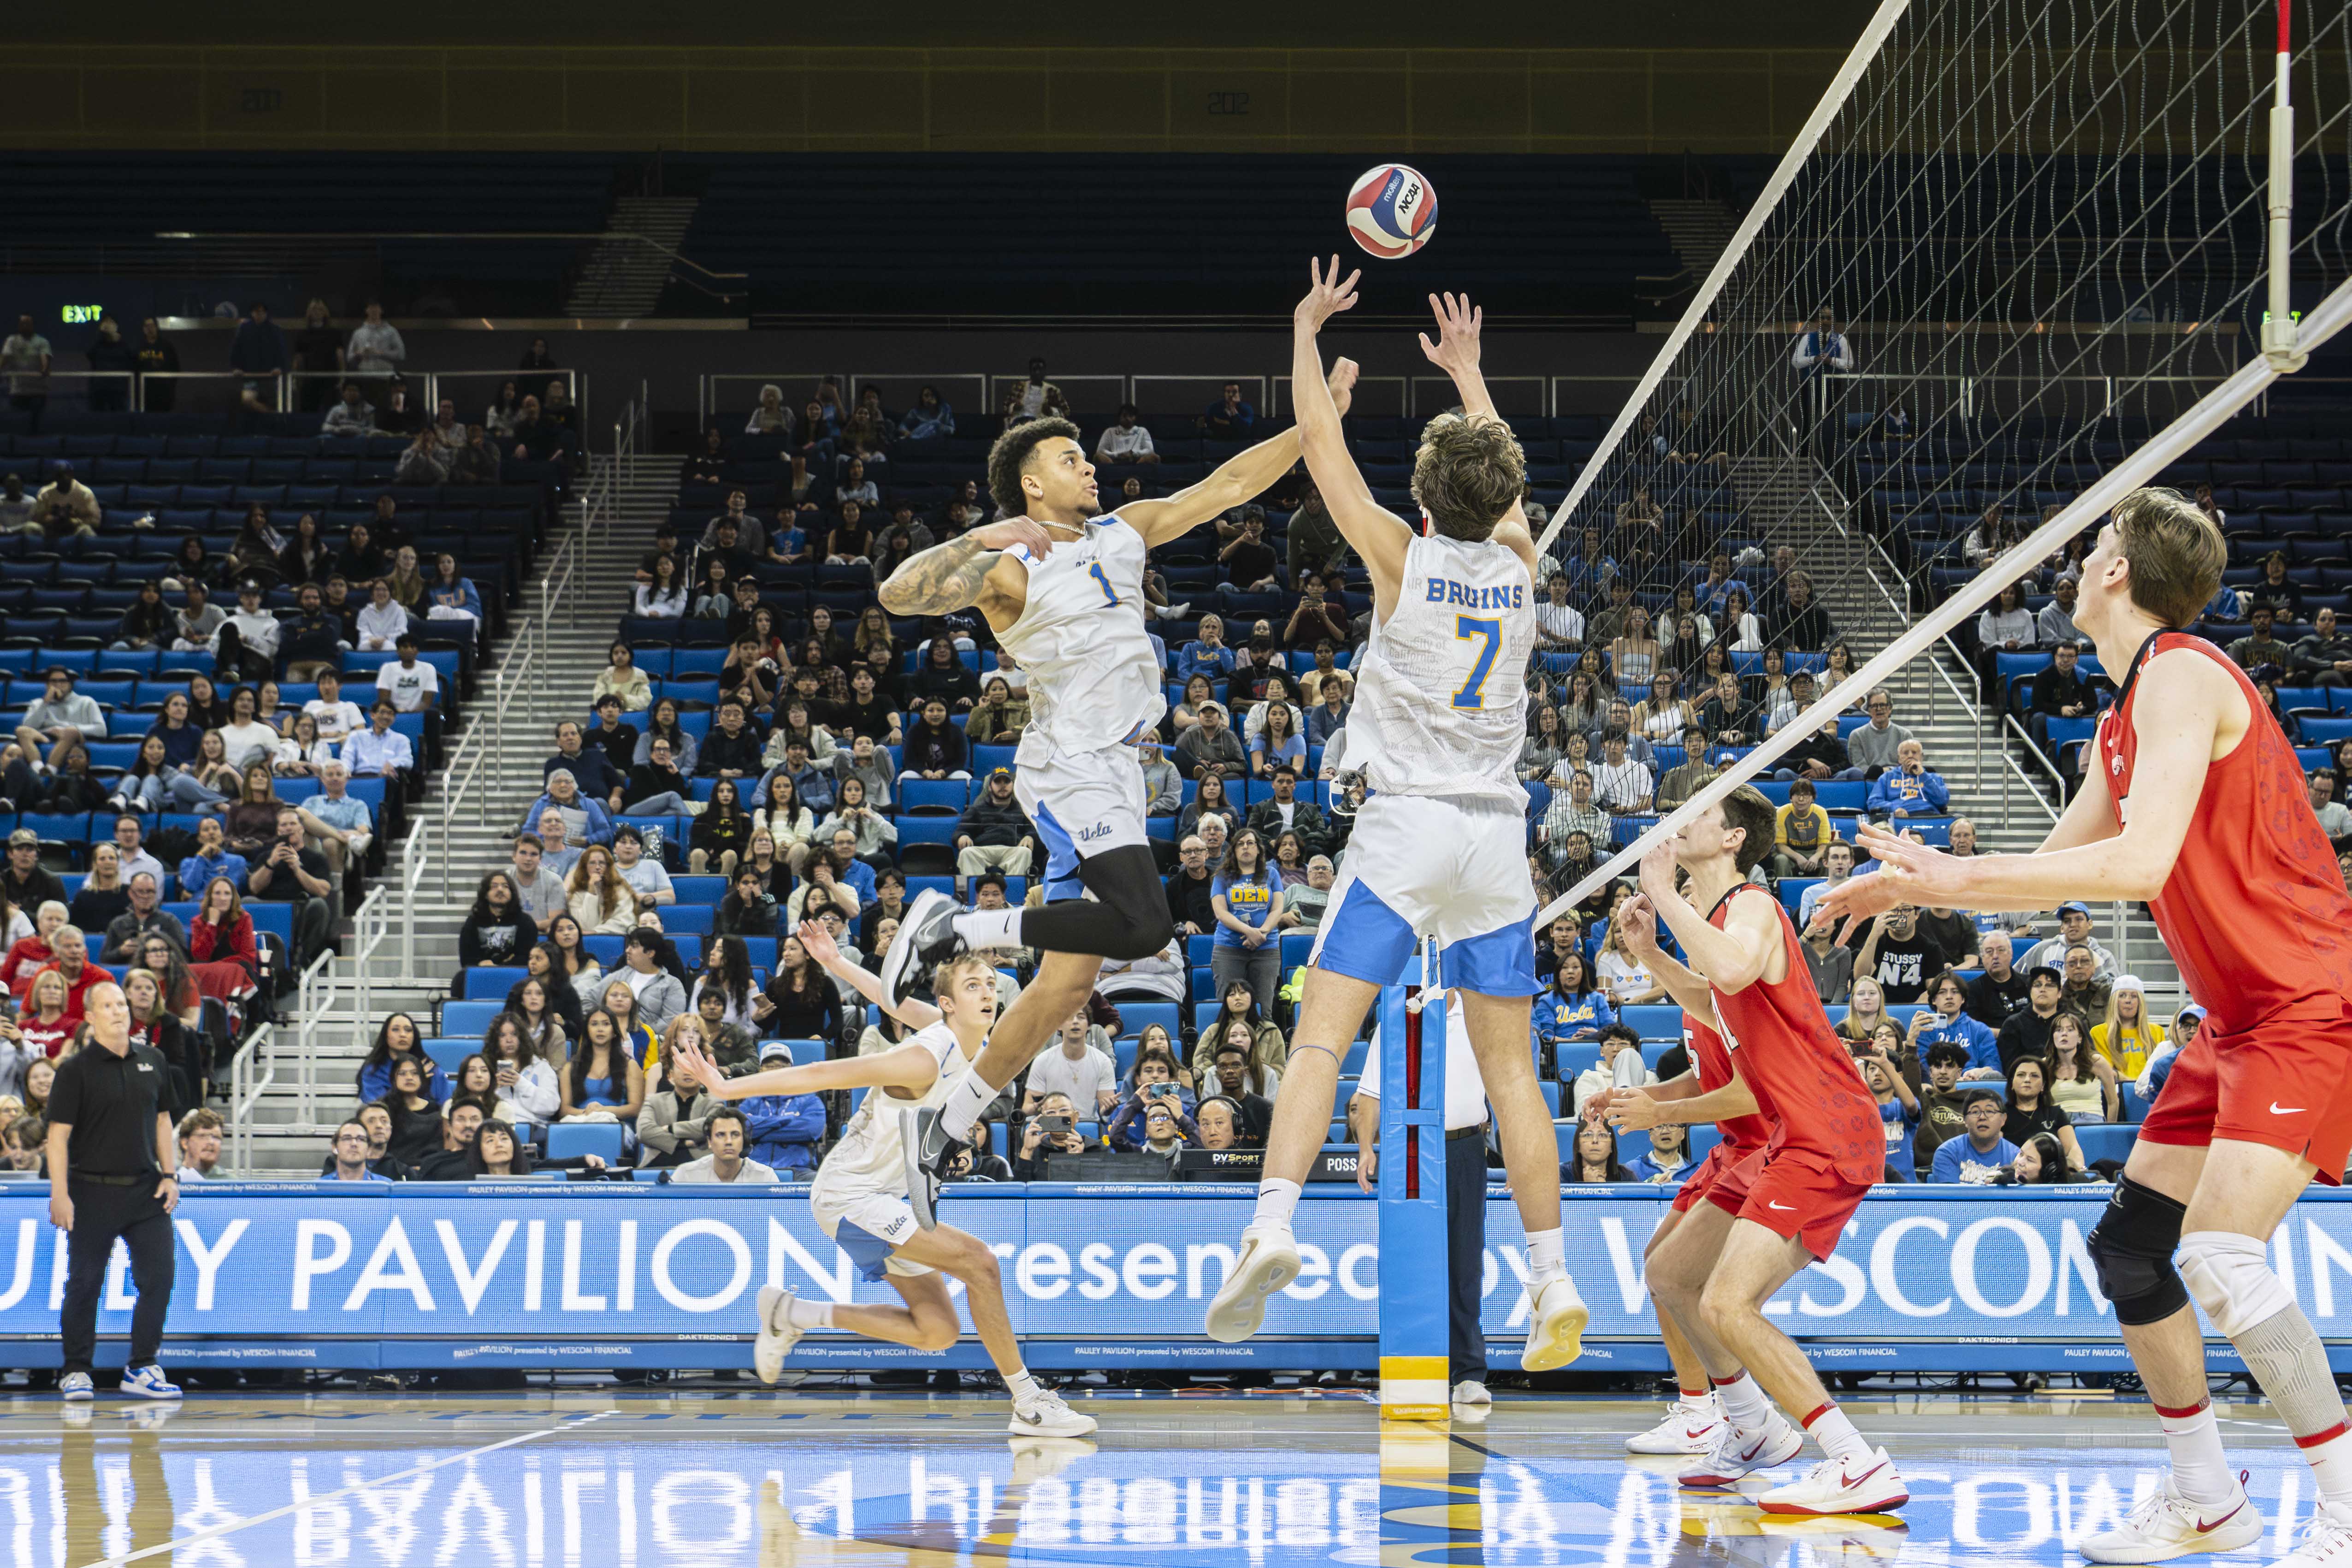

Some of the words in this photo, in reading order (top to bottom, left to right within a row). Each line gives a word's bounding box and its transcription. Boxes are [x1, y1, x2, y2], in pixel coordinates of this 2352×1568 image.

[1208, 92, 1250, 114] 202
[1383, 174, 1403, 203] molten
[1398, 182, 1421, 214] NCAA
[62, 304, 102, 324] EXIT
[2263, 311, 2301, 326] ET
[1088, 561, 1122, 608] 1
[1426, 577, 1523, 609] BRUINS
[1450, 614, 1502, 710] 7
[1078, 821, 1113, 841] Ucla
[1231, 888, 1269, 903] DEN
[1882, 951, 1923, 964] STUSSY
[1555, 1004, 1595, 1024] Ucla
[1327, 1157, 1358, 1172] POSS
[563, 1185, 572, 1194] by
[1138, 1185, 1171, 1194] presented
[1173, 1185, 1182, 1194] by
[884, 1214, 908, 1236] Ucla
[291, 1215, 853, 1315] PAVILION
[233, 1348, 242, 1357] by
[243, 1348, 277, 1356] WESCOM
[278, 1348, 316, 1356] FINANCIAL
[479, 1345, 512, 1354] PAVILION
[514, 1346, 547, 1355] presented
[549, 1346, 558, 1355] by
[594, 1346, 632, 1355] FINANCIAL
[828, 1348, 862, 1357] presented
[863, 1347, 872, 1357] by
[1136, 1347, 1170, 1356] presented
[1171, 1347, 1180, 1356] by
[1216, 1347, 1254, 1355] FINANCIAL
[1814, 1348, 1822, 1357] by
[1858, 1348, 1897, 1356] FINANCIAL
[2064, 1349, 2091, 1357] PAULEY
[2092, 1349, 2125, 1357] PAVILION
